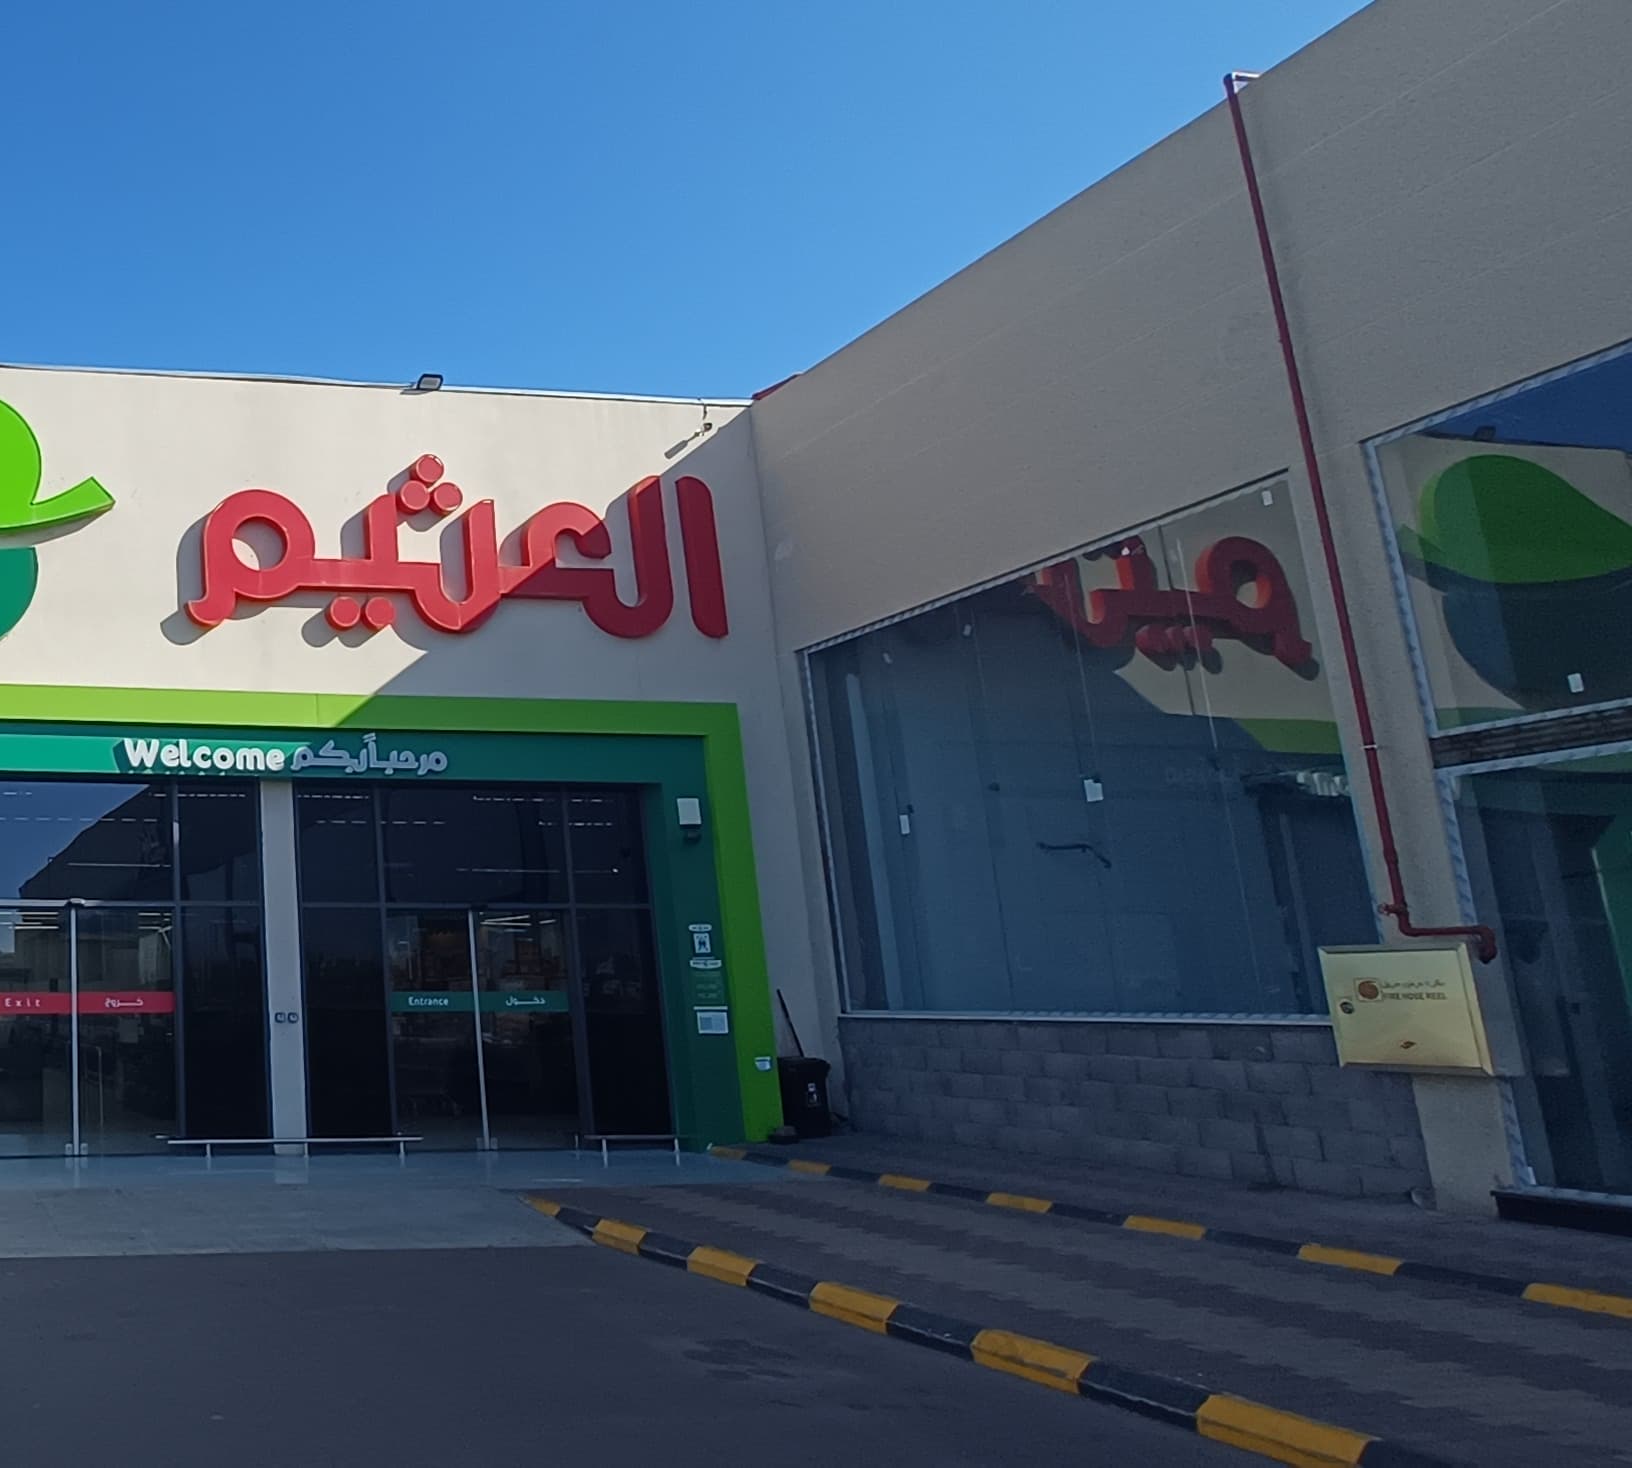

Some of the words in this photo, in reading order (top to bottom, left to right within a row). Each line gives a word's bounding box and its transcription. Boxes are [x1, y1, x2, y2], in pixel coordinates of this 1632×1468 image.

[184, 453, 730, 640] العثيم
[122, 738, 286, 772] Welcome
[290, 739, 368, 773] بكم
[4, 997, 42, 1008] Exit
[104, 997, 145, 1009] خروج
[408, 996, 449, 1007] Entrance
